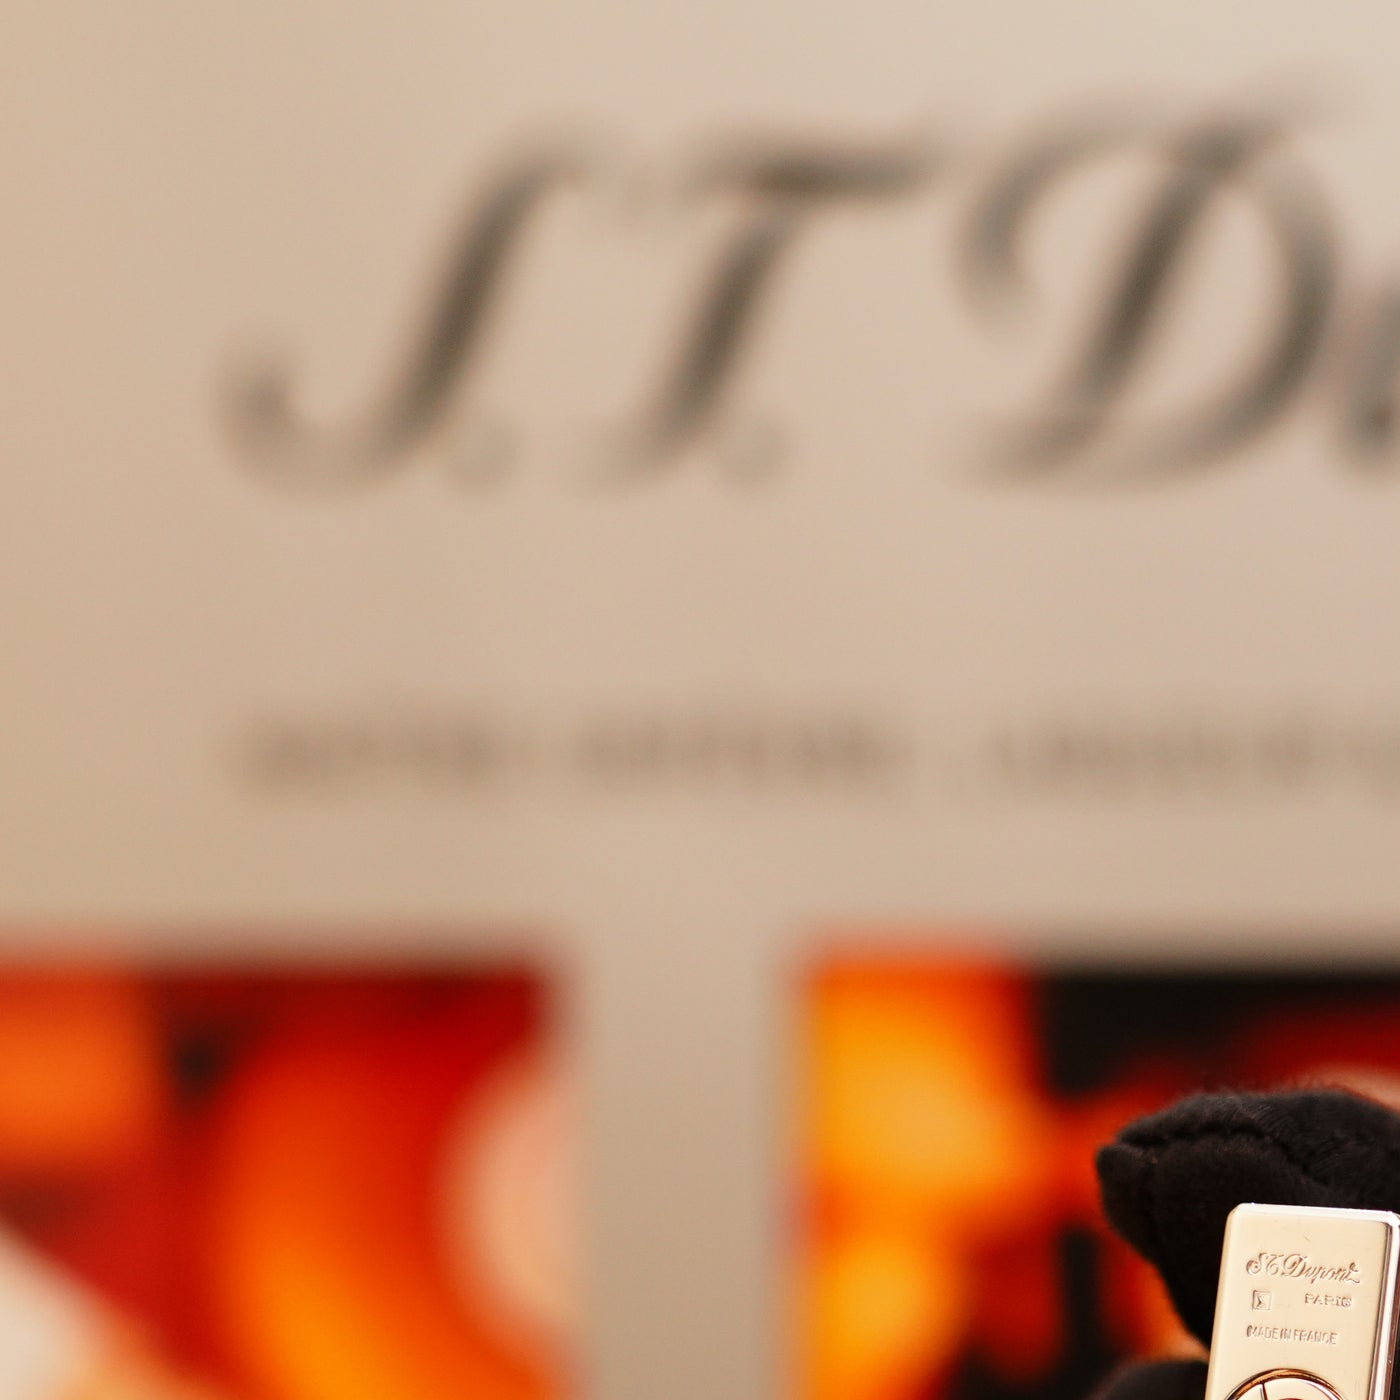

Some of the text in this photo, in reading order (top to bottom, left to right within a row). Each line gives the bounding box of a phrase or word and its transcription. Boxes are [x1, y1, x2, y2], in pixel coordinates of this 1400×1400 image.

[1283, 1253, 1360, 1284] Dupont
[1304, 1293, 1352, 1308] PARIS
[1246, 1325, 1338, 1345] MADE IN FRANCE
